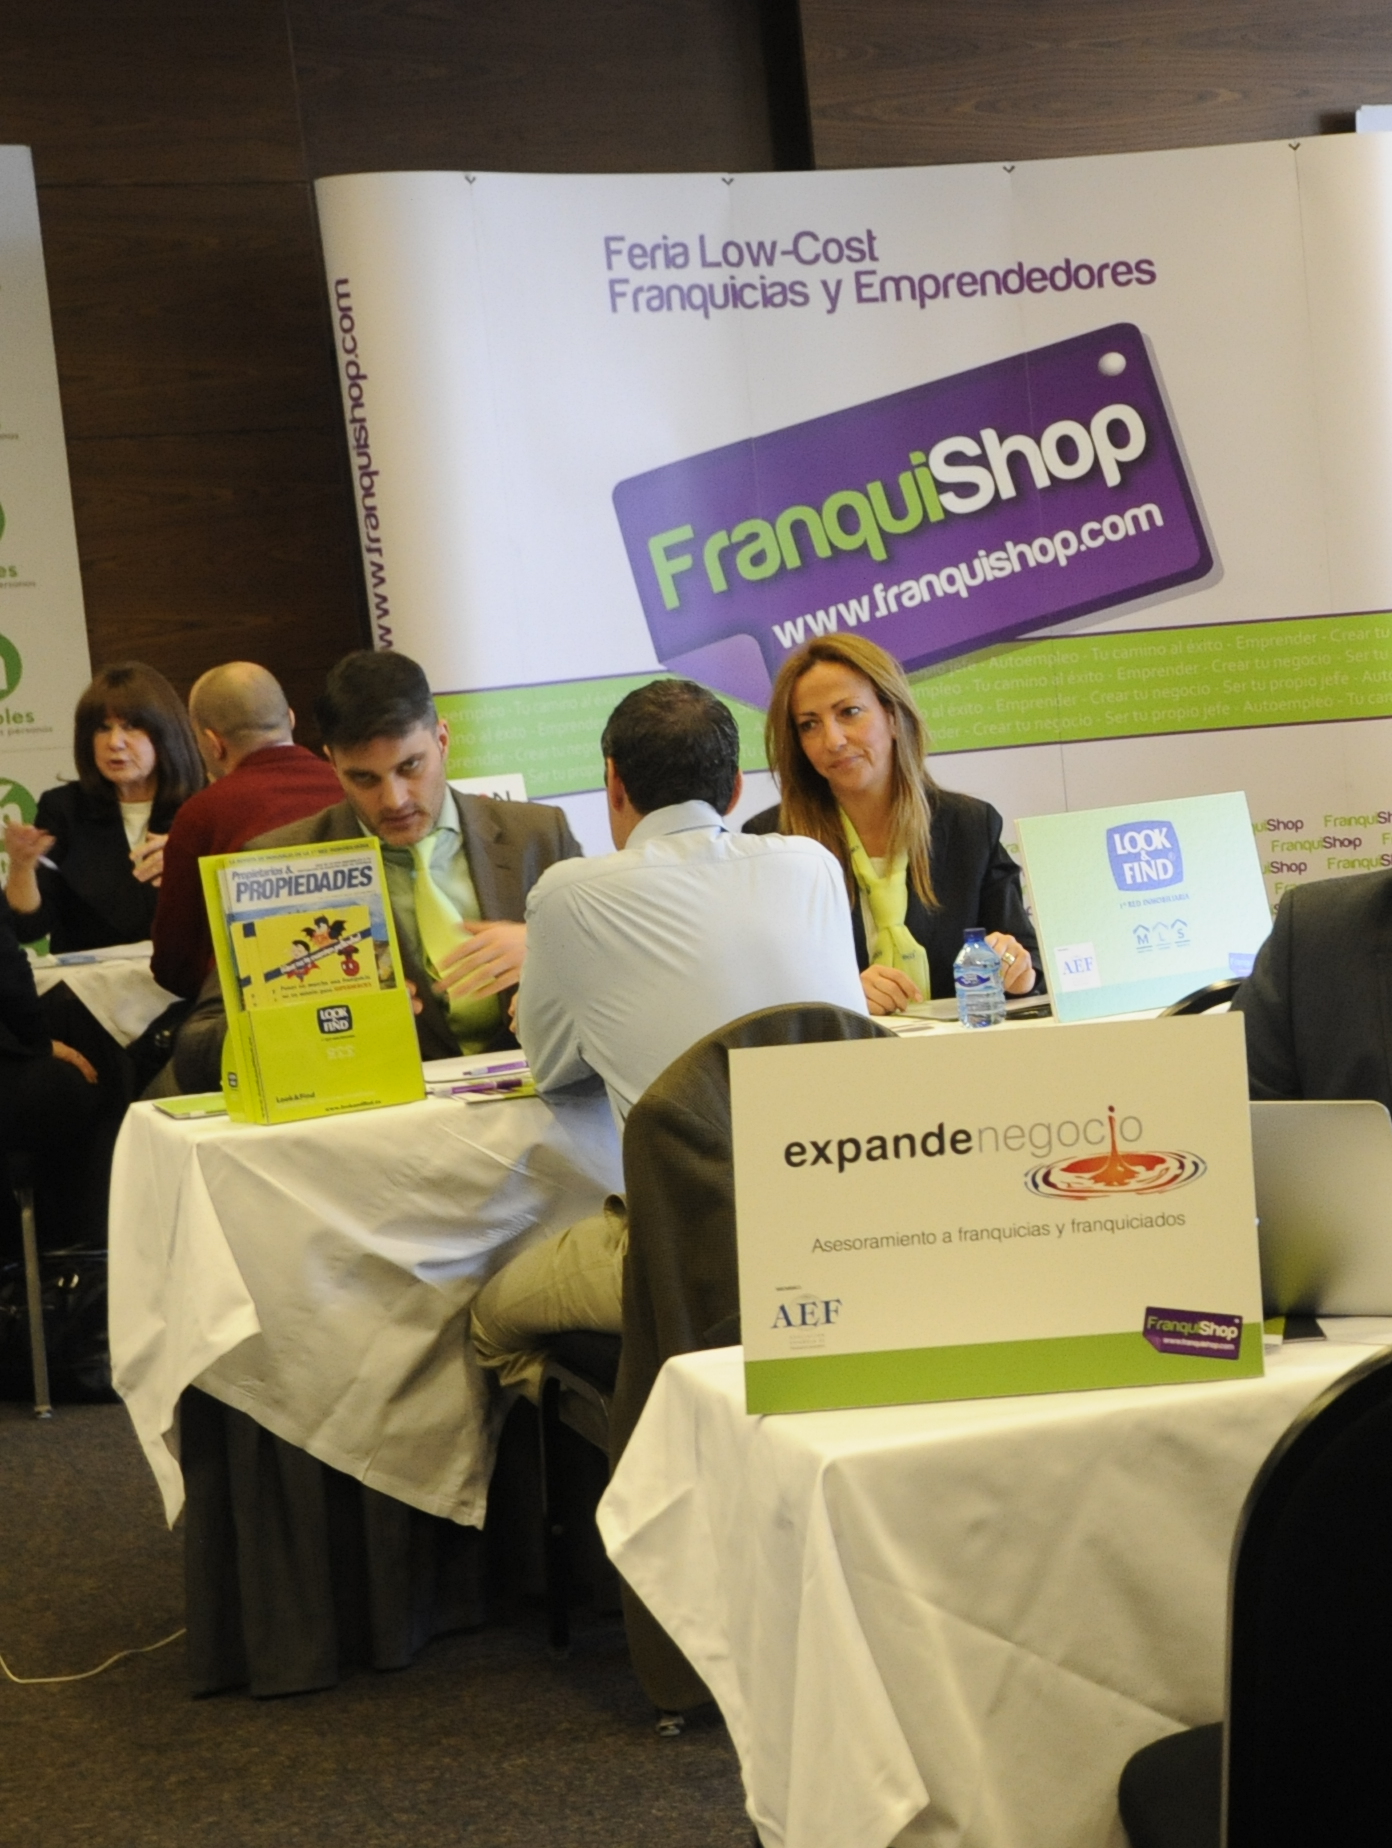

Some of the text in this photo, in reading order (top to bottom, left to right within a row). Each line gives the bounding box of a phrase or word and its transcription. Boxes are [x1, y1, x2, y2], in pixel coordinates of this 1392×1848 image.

[604, 229, 878, 271] Feria Low-Cost
[608, 255, 1157, 320] Franquicias y Emprendedores
[647, 403, 1147, 612] FranquiShop
[772, 503, 1164, 649] www.franquishop.com
[988, 650, 1080, 670] Autoempleo
[1091, 647, 1109, 662] Tu
[1112, 643, 1166, 661] camino
[1170, 641, 1183, 655] al
[1185, 638, 1224, 654] éxito
[1236, 630, 1317, 651] Emprender
[1330, 628, 1371, 643] Crear
[1374, 627, 1390, 639] tu
[974, 678, 990, 692] Tu
[994, 675, 1048, 691] camino
[1052, 672, 1064, 686] al
[1067, 668, 1104, 684] éxito
[1117, 663, 1200, 682] Emprender
[1212, 658, 1252, 674] Crear
[1254, 657, 1270, 669] tu
[1273, 652, 1332, 671] negocio
[1345, 649, 1369, 664] Ser
[1373, 648, 1388, 660] tu
[950, 701, 984, 718] éxito
[996, 693, 1076, 713] Emprender
[1090, 689, 1129, 704] Crear
[1133, 687, 1148, 700] tu
[1152, 684, 1211, 702] negocio
[1223, 680, 1247, 694] Ser
[1251, 679, 1266, 692] tu
[1269, 674, 1318, 692] propio
[1320, 671, 1350, 691] jefe
[972, 720, 1012, 736] Crear
[1015, 719, 1031, 732] tu
[1034, 714, 1092, 736] negocio
[1105, 710, 1129, 725] Ser
[1133, 709, 1148, 723] tu
[1152, 703, 1200, 724] propio
[1202, 701, 1231, 720] jefe
[1242, 694, 1334, 714] Autoempleo
[1346, 692, 1364, 706] Tu
[1113, 826, 1172, 856] LOOK
[1271, 836, 1362, 854] FranquiShop
[236, 865, 373, 903] PROPIEDADES
[1123, 858, 1174, 885] FIND
[1063, 956, 1094, 976] AEF
[320, 1007, 349, 1020] LOOK
[784, 1105, 1143, 1174] expandenegocio
[812, 1211, 1187, 1254] Asesoramiento a franquicias y franquiciados
[771, 1298, 843, 1329] AEF
[1147, 1316, 1239, 1341] FranquiShop
